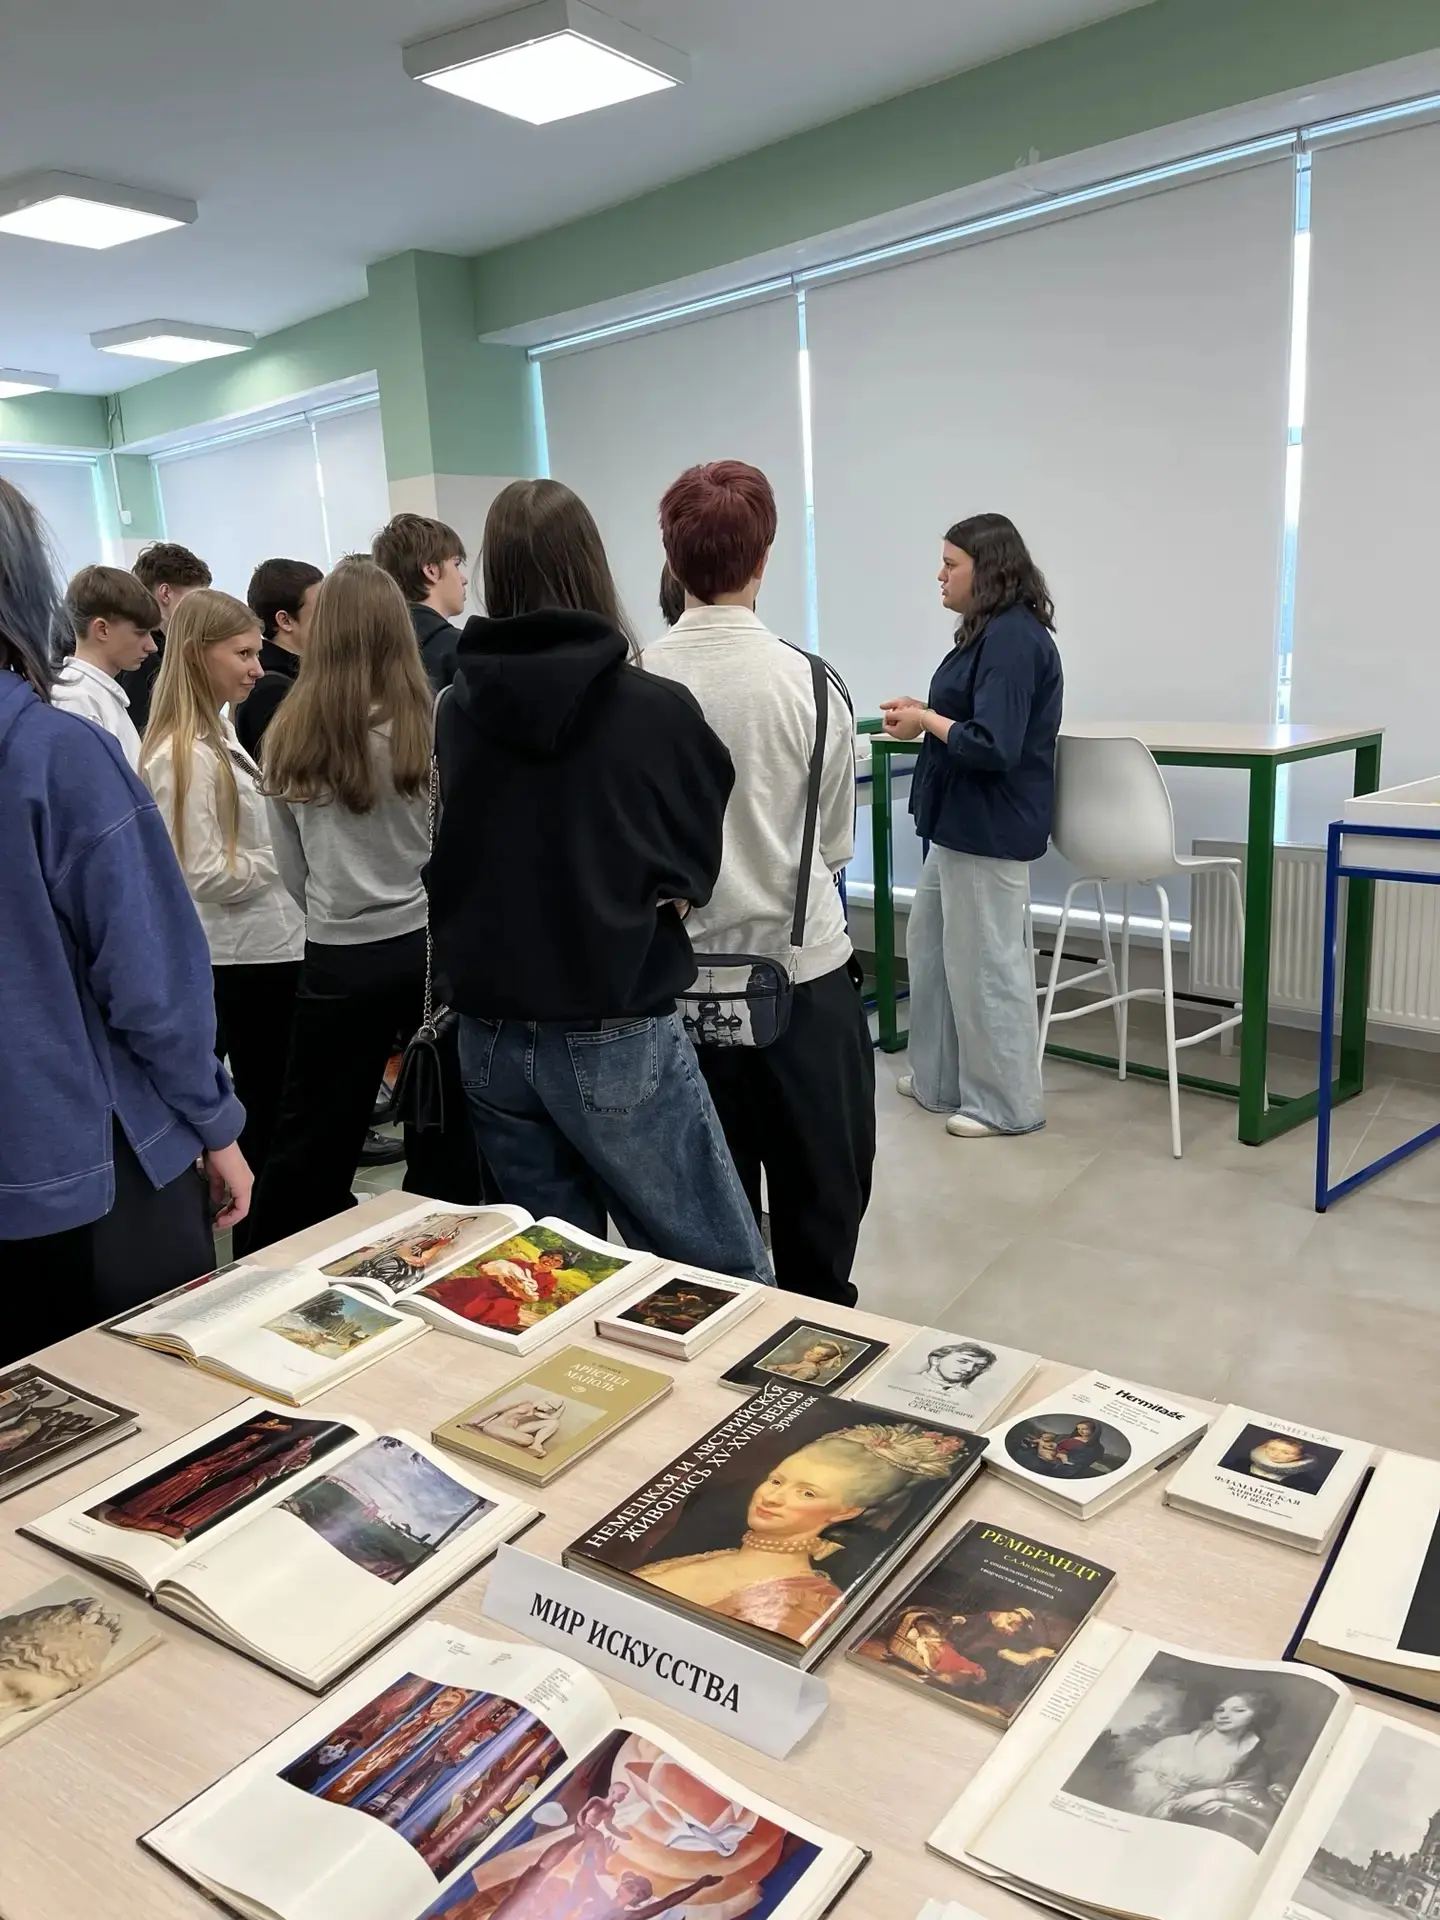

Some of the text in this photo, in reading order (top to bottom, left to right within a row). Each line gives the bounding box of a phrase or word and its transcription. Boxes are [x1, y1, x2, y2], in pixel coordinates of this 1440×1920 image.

[769, 1395, 819, 1433] Эрмитаж
[1115, 1389, 1185, 1421] Hermitage
[585, 1384, 788, 1548] НЕМЕЦКАЯ И АВСТРИЙСКАЯ
[619, 1467, 713, 1543] ЖИВОПИСЬ
[759, 1390, 804, 1423] ВЕКОВ
[1214, 1475, 1301, 1506] ФЛАМАНДСКАЯ
[980, 1529, 1101, 1581] РЕМБРАНДТ
[529, 1592, 585, 1636] МИР
[586, 1619, 742, 1713] ИСКУССТВА
